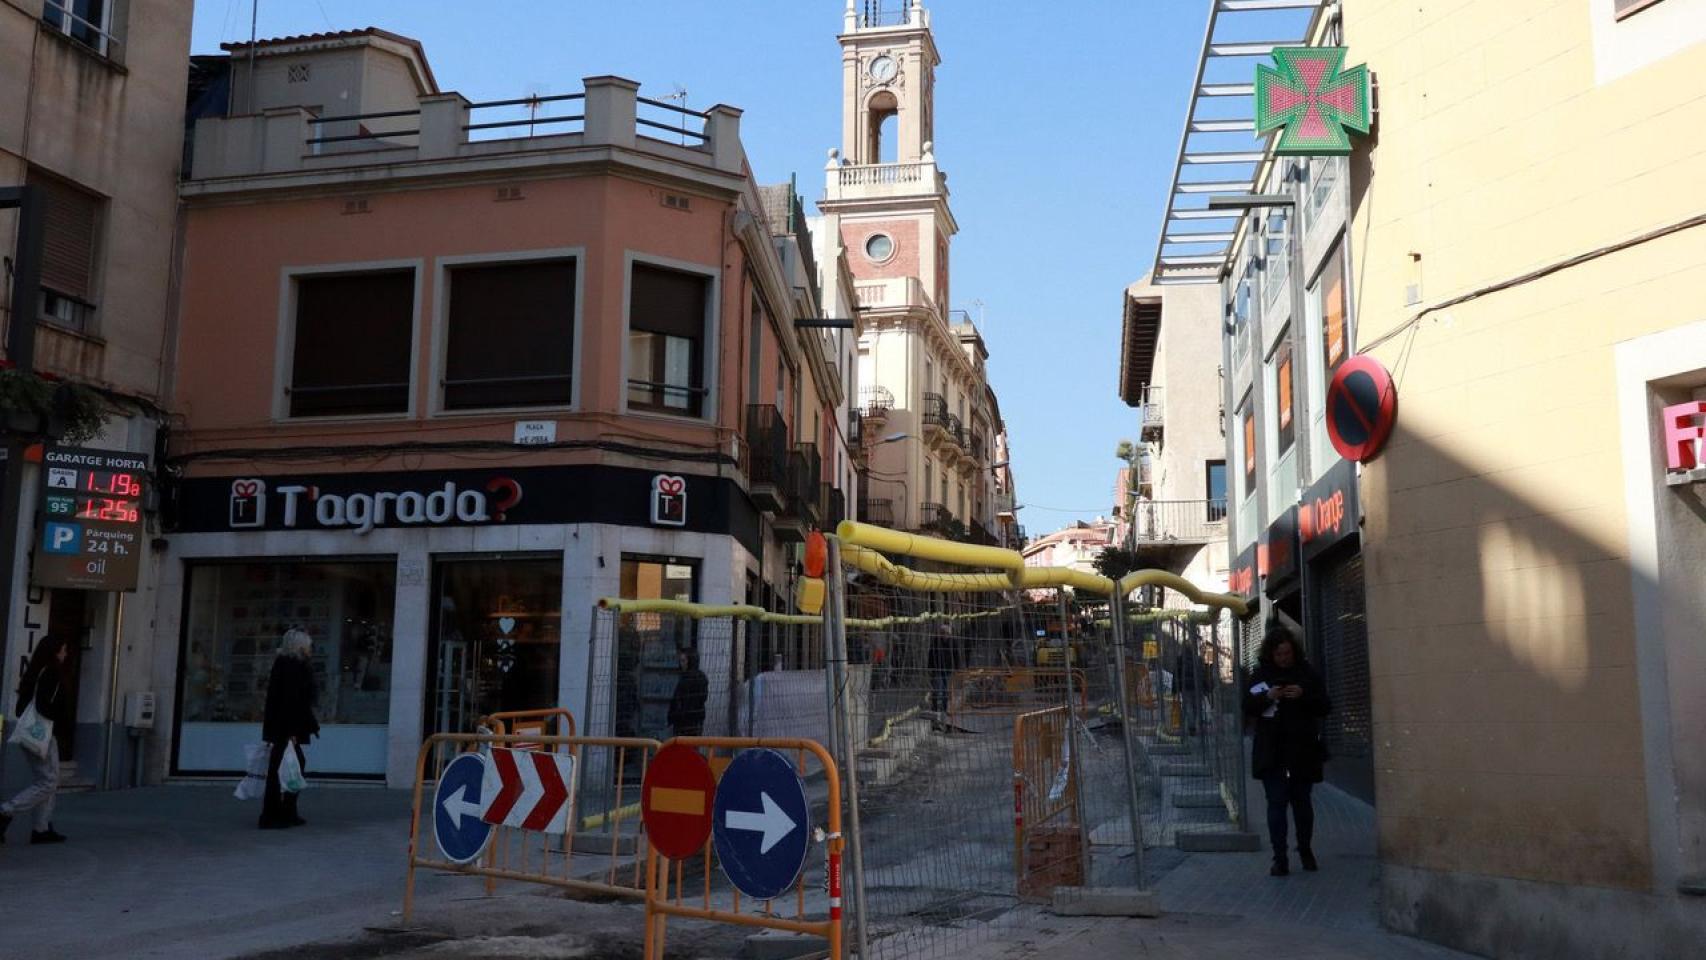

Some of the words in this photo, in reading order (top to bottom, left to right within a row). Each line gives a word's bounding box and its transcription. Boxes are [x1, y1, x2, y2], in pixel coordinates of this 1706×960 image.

[1663, 401, 1706, 469] F
[46, 452, 102, 466] GARATGE
[106, 457, 146, 470] HORTA
[56, 476, 68, 486] A
[51, 502, 68, 513] 95
[1317, 489, 1344, 535] Orange
[53, 526, 74, 549] P
[86, 528, 134, 543] Parquing
[86, 540, 108, 553] 24
